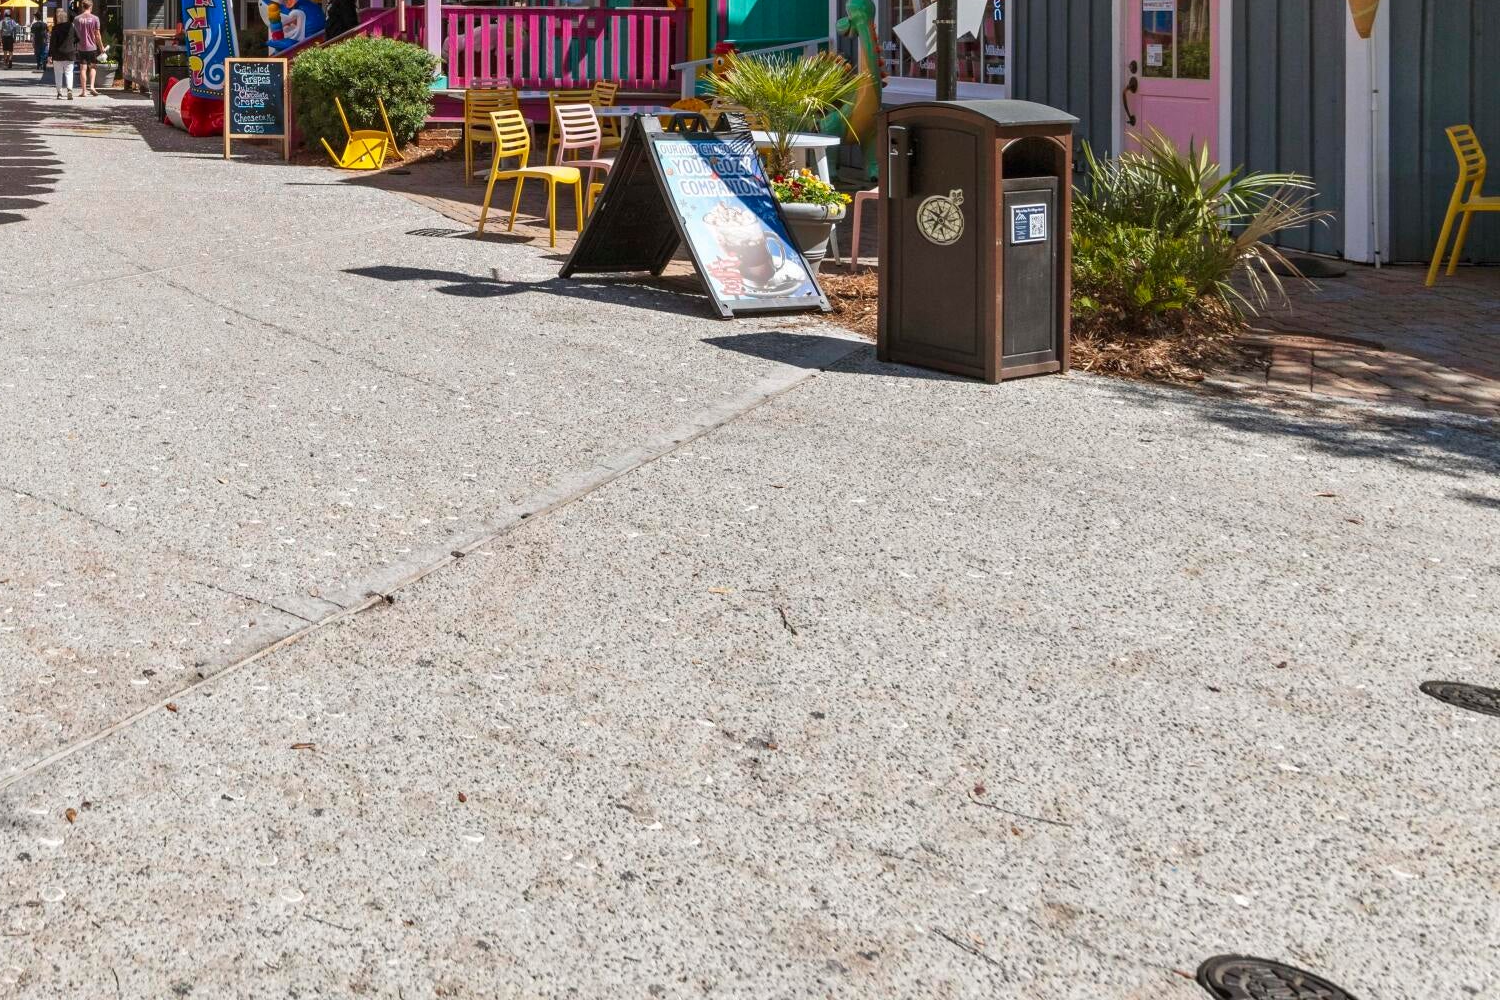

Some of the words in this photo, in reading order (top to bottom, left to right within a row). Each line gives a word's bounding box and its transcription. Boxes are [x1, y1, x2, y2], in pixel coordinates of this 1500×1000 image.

[242, 74, 271, 86] Grapes
[234, 97, 265, 107] Crepes
[660, 144, 679, 155] OUR
[680, 144, 699, 155] HOT
[700, 143, 754, 156] CHOCOL
[672, 159, 713, 175] YOUR
[716, 158, 752, 176] COZY
